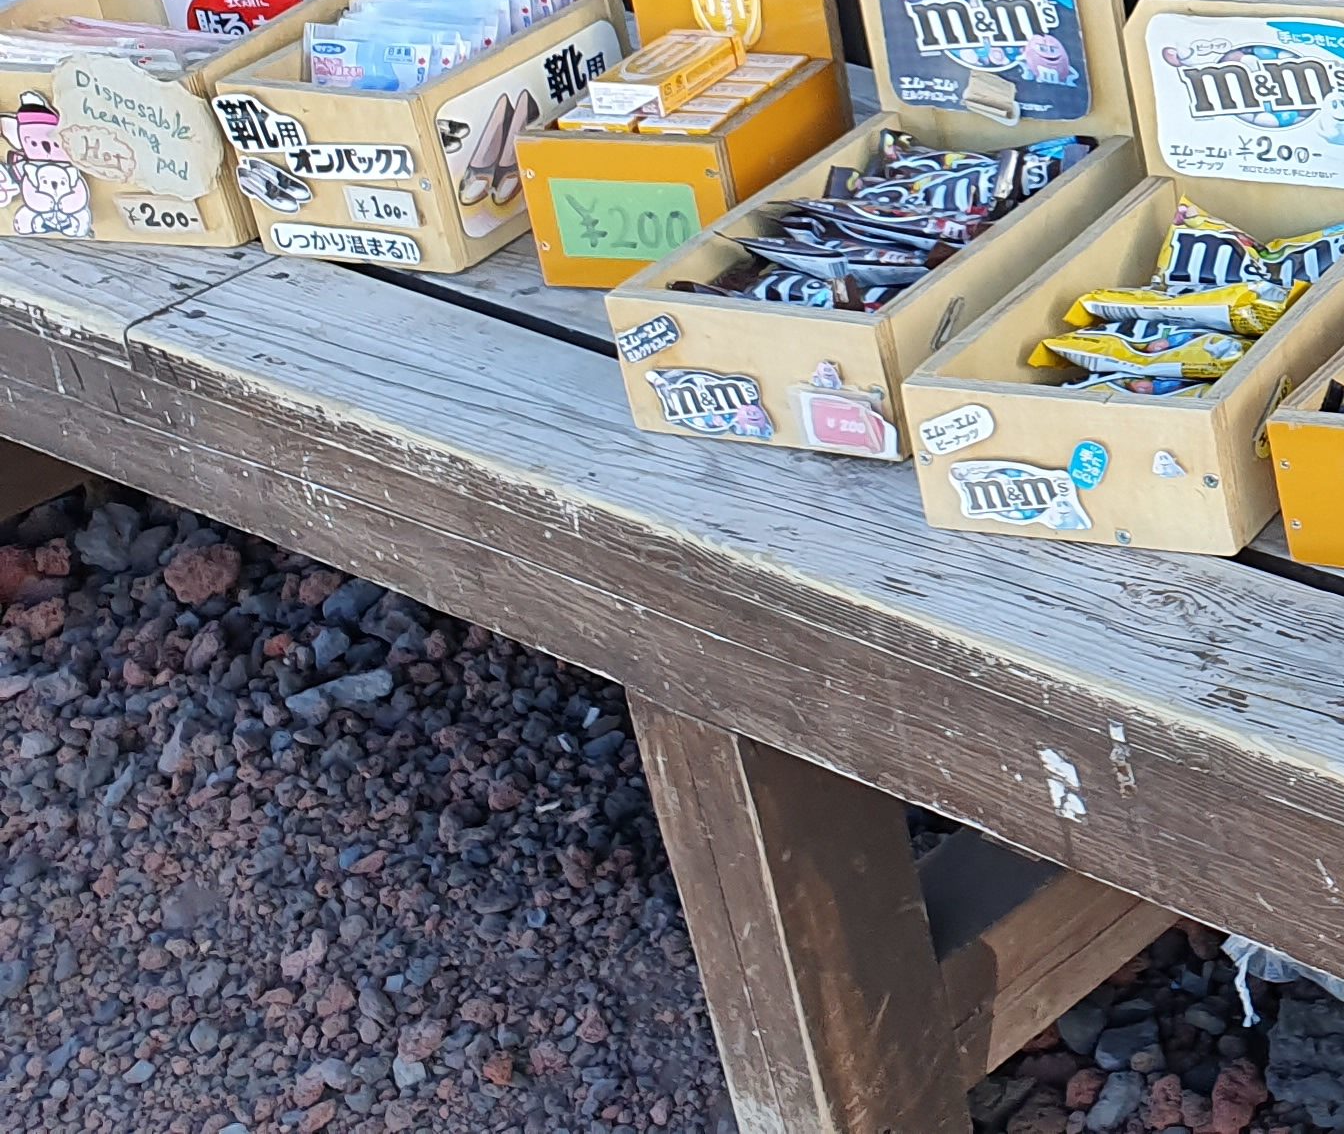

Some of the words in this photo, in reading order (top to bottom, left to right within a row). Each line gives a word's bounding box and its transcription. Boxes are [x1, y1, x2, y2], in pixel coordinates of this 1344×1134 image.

[543, 44, 607, 104] 靴用
[76, 70, 193, 140] Disposable
[217, 100, 300, 150] 靴用
[288, 148, 412, 176] オンパックス
[564, 193, 690, 249] ¥200
